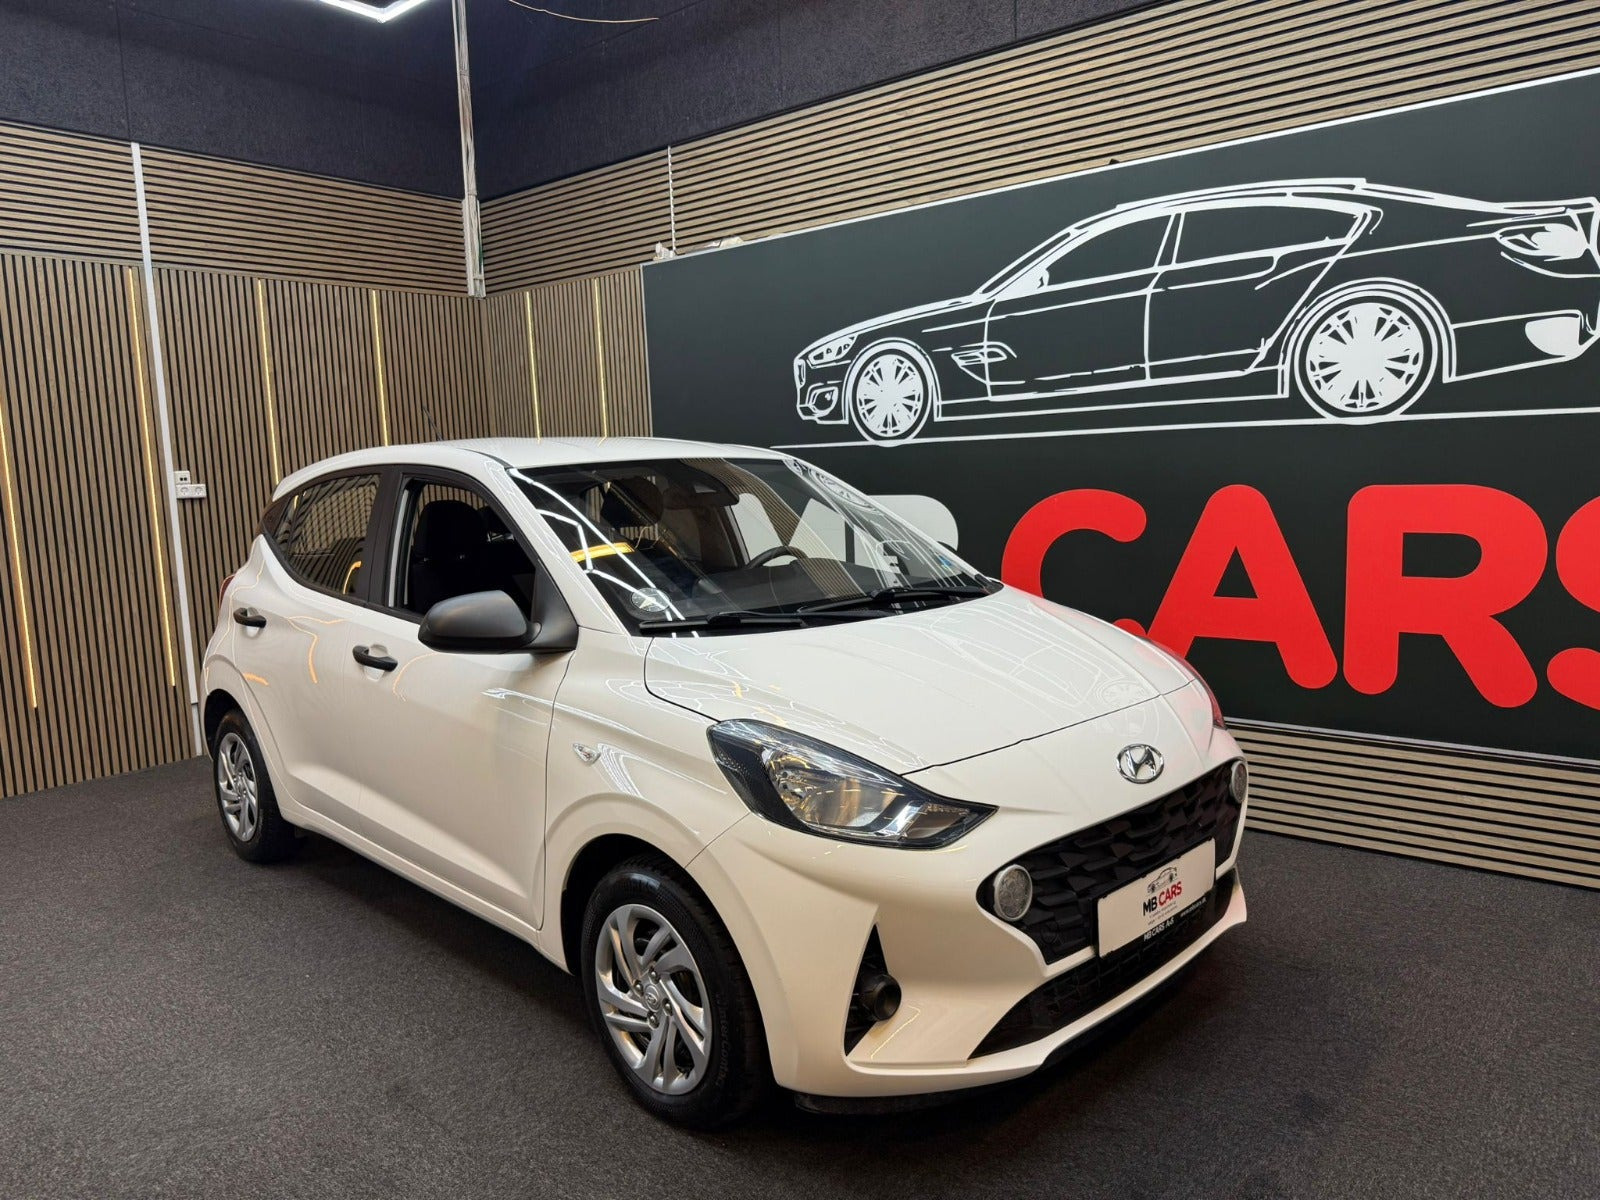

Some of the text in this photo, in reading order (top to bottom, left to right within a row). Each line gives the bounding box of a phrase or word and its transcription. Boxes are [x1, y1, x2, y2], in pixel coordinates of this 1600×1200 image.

[1002, 484, 1600, 710] CAR
[1143, 896, 1158, 916] MB
[1159, 881, 1182, 906] CARS
